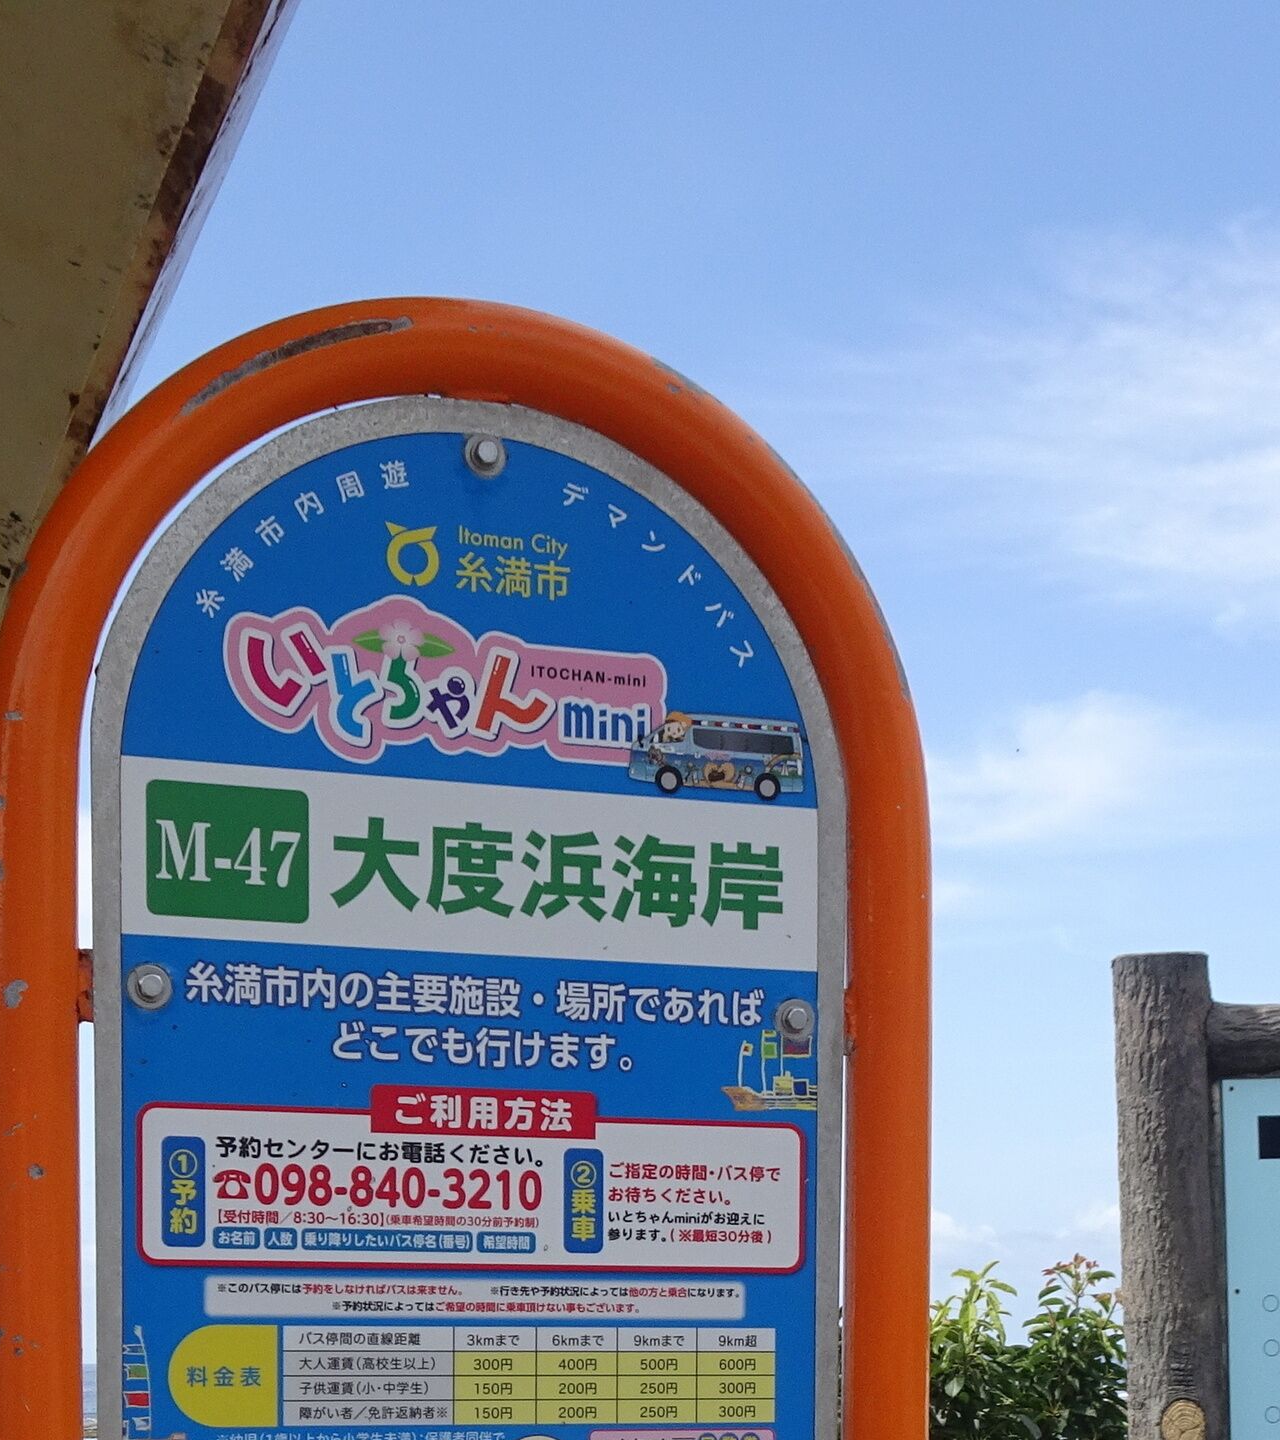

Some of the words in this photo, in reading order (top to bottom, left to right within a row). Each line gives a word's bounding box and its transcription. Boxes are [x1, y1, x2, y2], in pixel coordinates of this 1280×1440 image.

[195, 459, 410, 620] 糸満市内周遊
[458, 525, 524, 551] Itoman
[532, 533, 570, 558] City
[455, 552, 571, 601] 糸満市
[562, 482, 755, 668] デマンドバス
[242, 628, 552, 744] いとちゃん
[530, 665, 647, 688] ITOCHAN-mini
[563, 701, 646, 743] mini
[155, 818, 301, 887] M-47
[330, 816, 783, 930] 大度浜海岸
[185, 961, 764, 1027] 糸満市内の主要施設・場所であれば
[331, 1021, 634, 1072] どこでも行けます。
[395, 1093, 573, 1132] ご利用方法
[215, 1136, 543, 1168] 予約センターにお電話ください。
[609, 1162, 781, 1182] ご指定の時間・バス停で
[254, 1162, 543, 1210] 098-840-3210
[608, 1187, 731, 1206] お待ちください。
[608, 1210, 765, 1226] いとちゃんminiがお迎えに
[218, 1231, 256, 1246] お名前
[267, 1231, 294, 1247] 人数
[303, 1231, 471, 1250] 乗り降りしたいバス停名（番号）
[482, 1234, 531, 1252] 希望時間
[299, 1332, 421, 1346] バス停間の直線距離
[467, 1334, 519, 1347] 3kmまで
[552, 1334, 604, 1347] 6kmまで
[634, 1335, 685, 1347] 9kmまで
[718, 1335, 757, 1347] 9km超
[186, 1366, 262, 1388] 料金表
[299, 1357, 436, 1371] 大人運賃（高校生以上）
[474, 1359, 513, 1371] 300円
[558, 1359, 597, 1371] 400円
[640, 1359, 678, 1371] 500円
[719, 1359, 756, 1371] 600円
[474, 1383, 513, 1395] 150円
[558, 1383, 597, 1395] 200円
[640, 1383, 678, 1395] 250円
[719, 1383, 756, 1395] 300円
[474, 1406, 513, 1420] 150円
[558, 1406, 597, 1420] 200円
[640, 1406, 678, 1420] 250円
[719, 1406, 756, 1420] 300円
